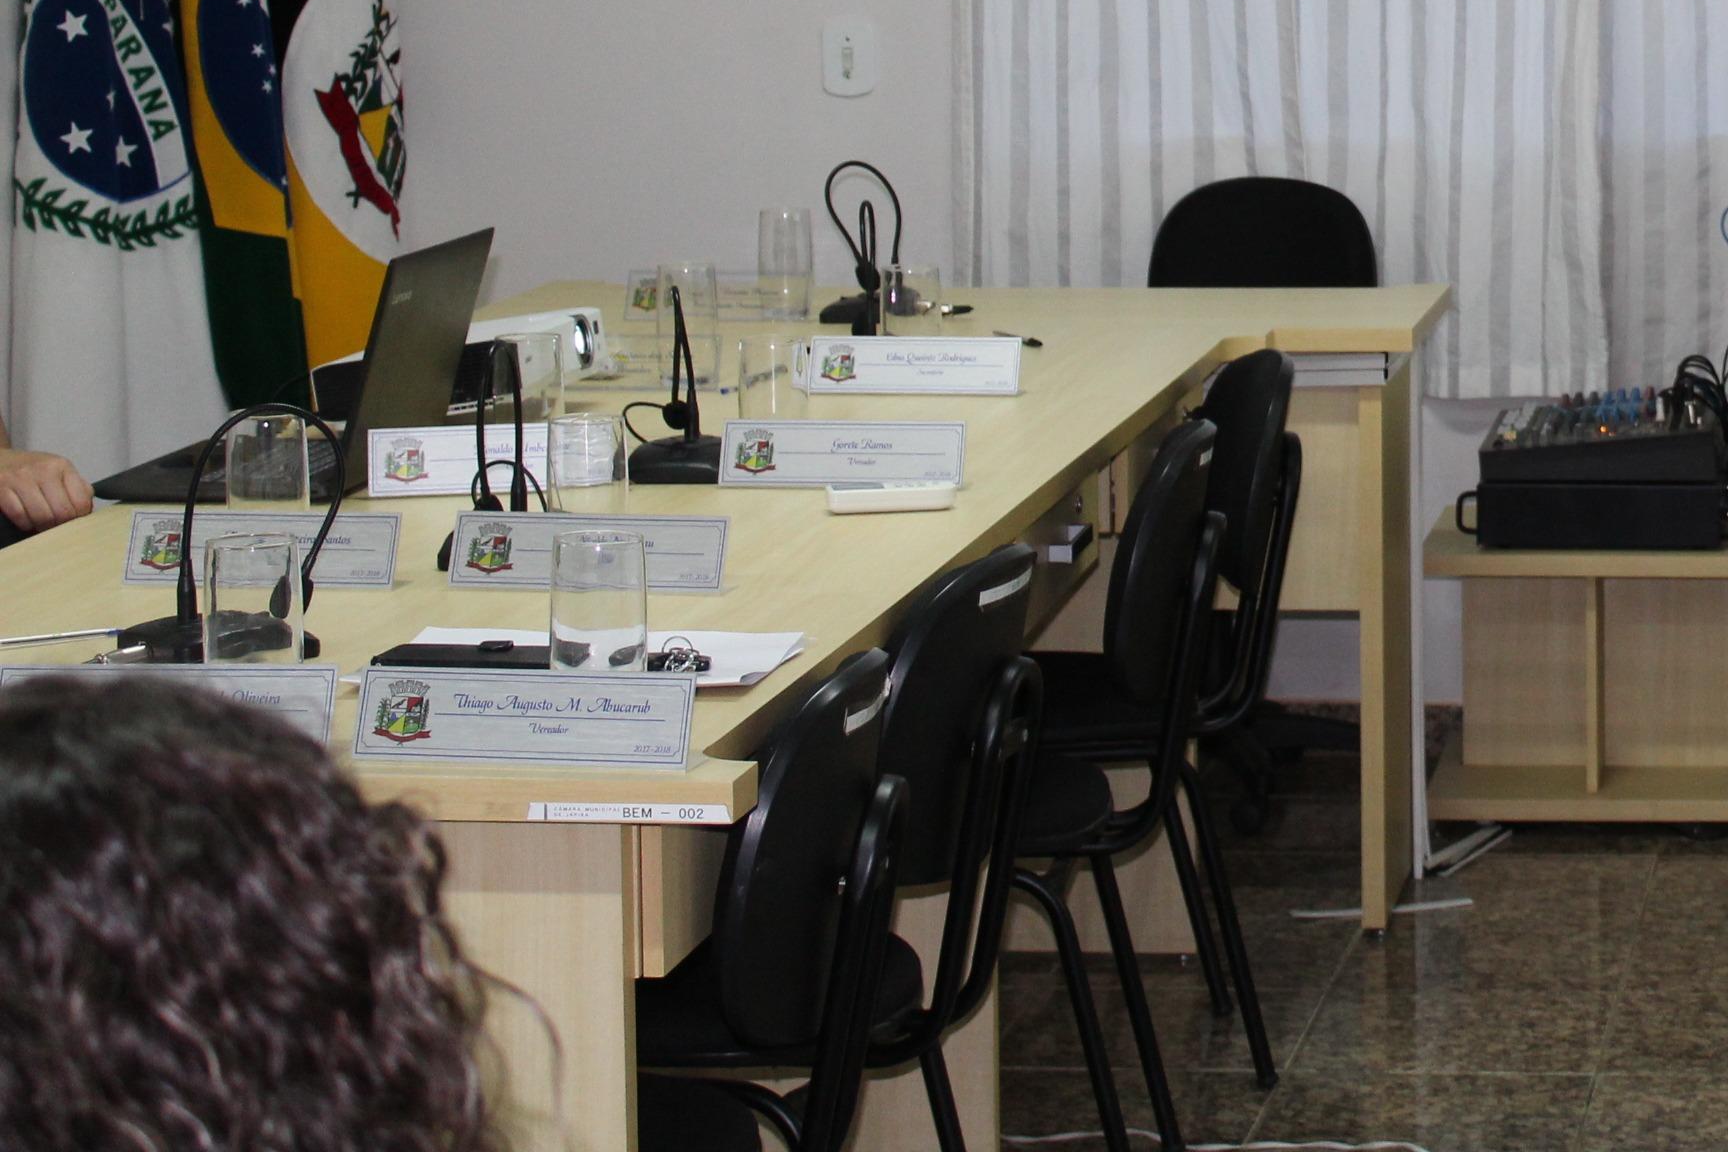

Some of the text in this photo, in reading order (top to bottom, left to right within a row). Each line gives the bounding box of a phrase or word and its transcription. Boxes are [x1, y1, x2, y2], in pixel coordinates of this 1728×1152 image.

[453, 693, 651, 715] Thiago Augusto M. Abucarub
[528, 722, 569, 735] Vereador
[622, 807, 653, 819] BEM
[678, 808, 705, 820] 002
